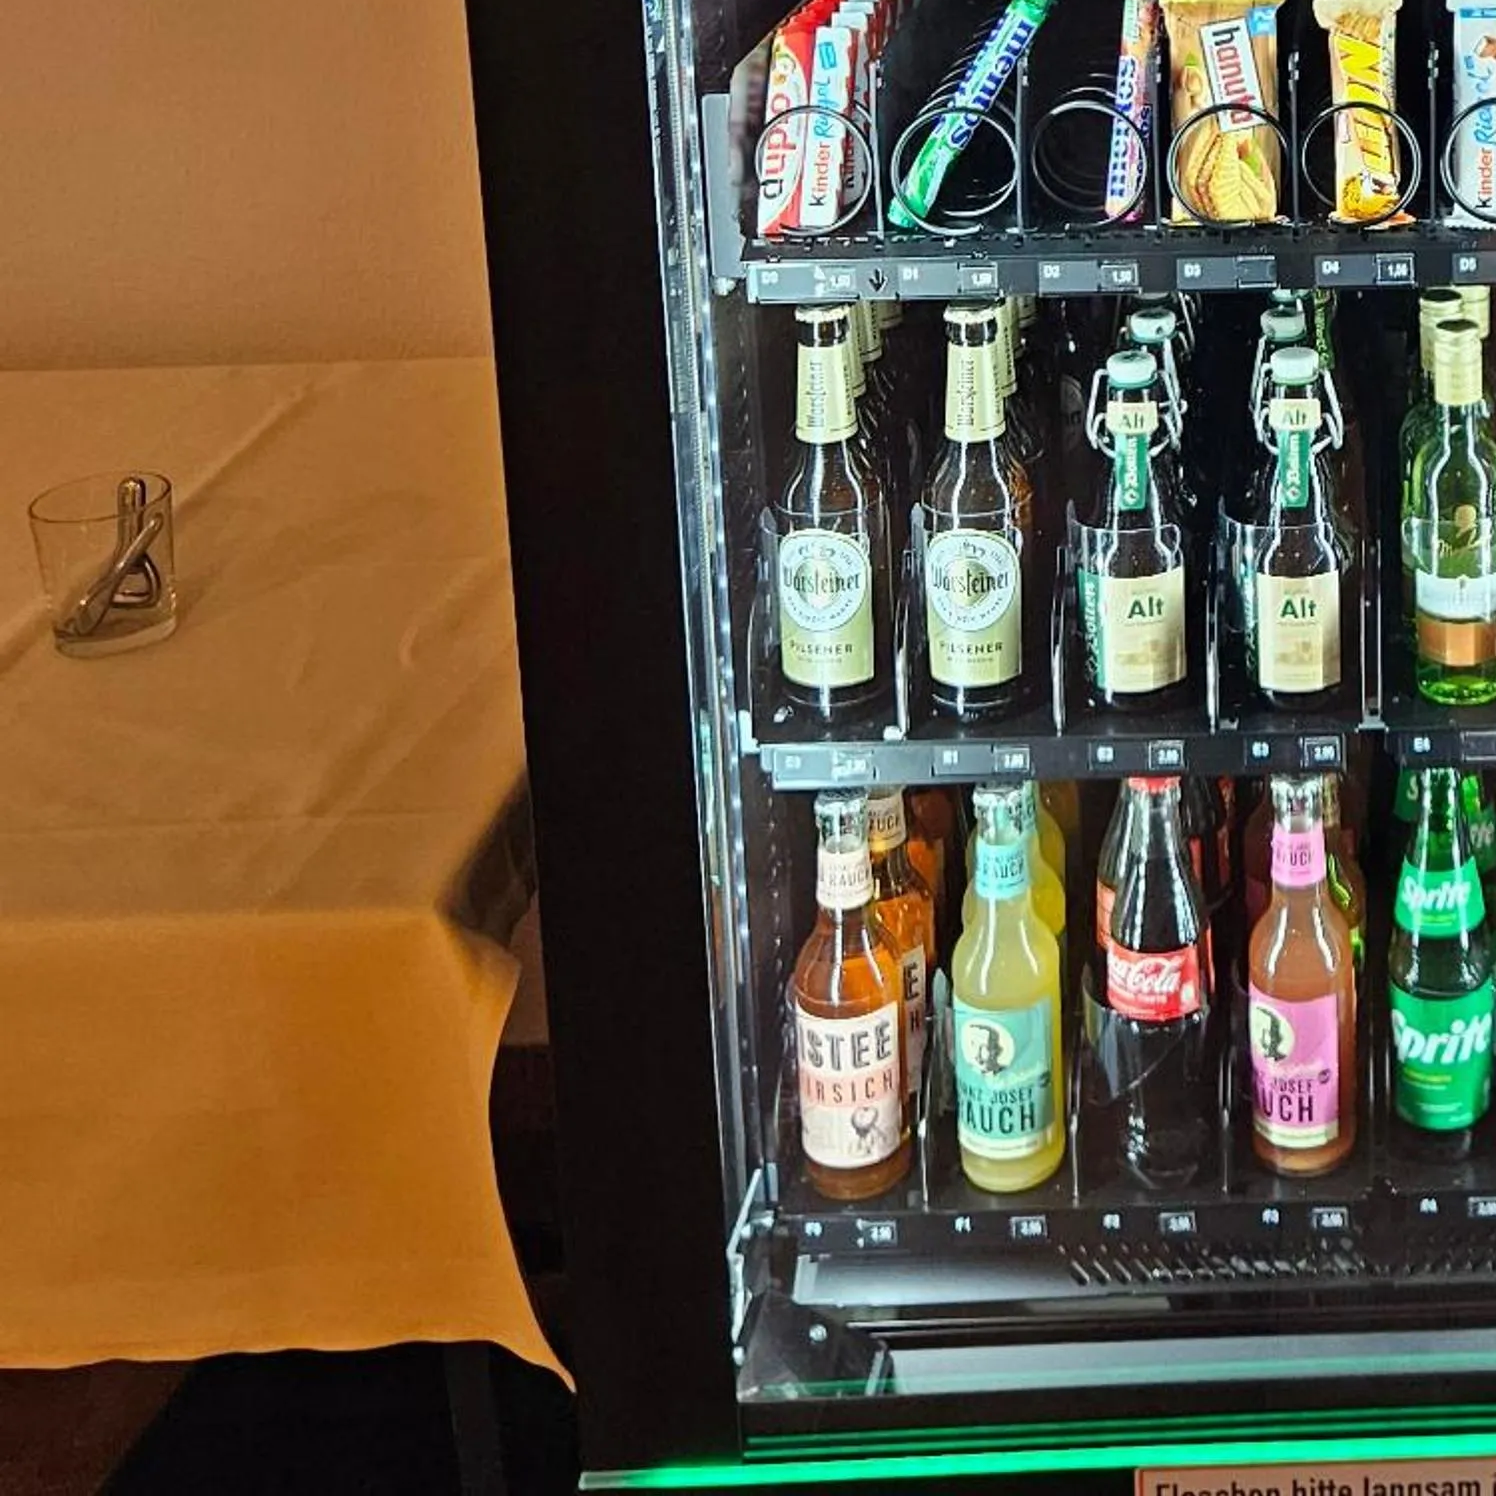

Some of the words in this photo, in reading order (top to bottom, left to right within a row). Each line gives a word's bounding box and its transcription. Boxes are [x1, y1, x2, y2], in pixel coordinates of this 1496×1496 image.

[1212, 26, 1251, 126] hanuta
[1117, 411, 1146, 430] Alt
[1281, 408, 1308, 427] Alt
[783, 562, 862, 602] Warsteiner
[931, 561, 1011, 600] Warsteiner
[1126, 594, 1165, 620] Alt
[1278, 595, 1319, 620] Alt
[788, 639, 855, 655] PILSENER
[938, 639, 1004, 655] PILSENER
[802, 1020, 893, 1070] STEE
[805, 1075, 894, 1105] IRSICH
[962, 1103, 1037, 1136] AUCH
[1258, 1092, 1315, 1123] UCH
